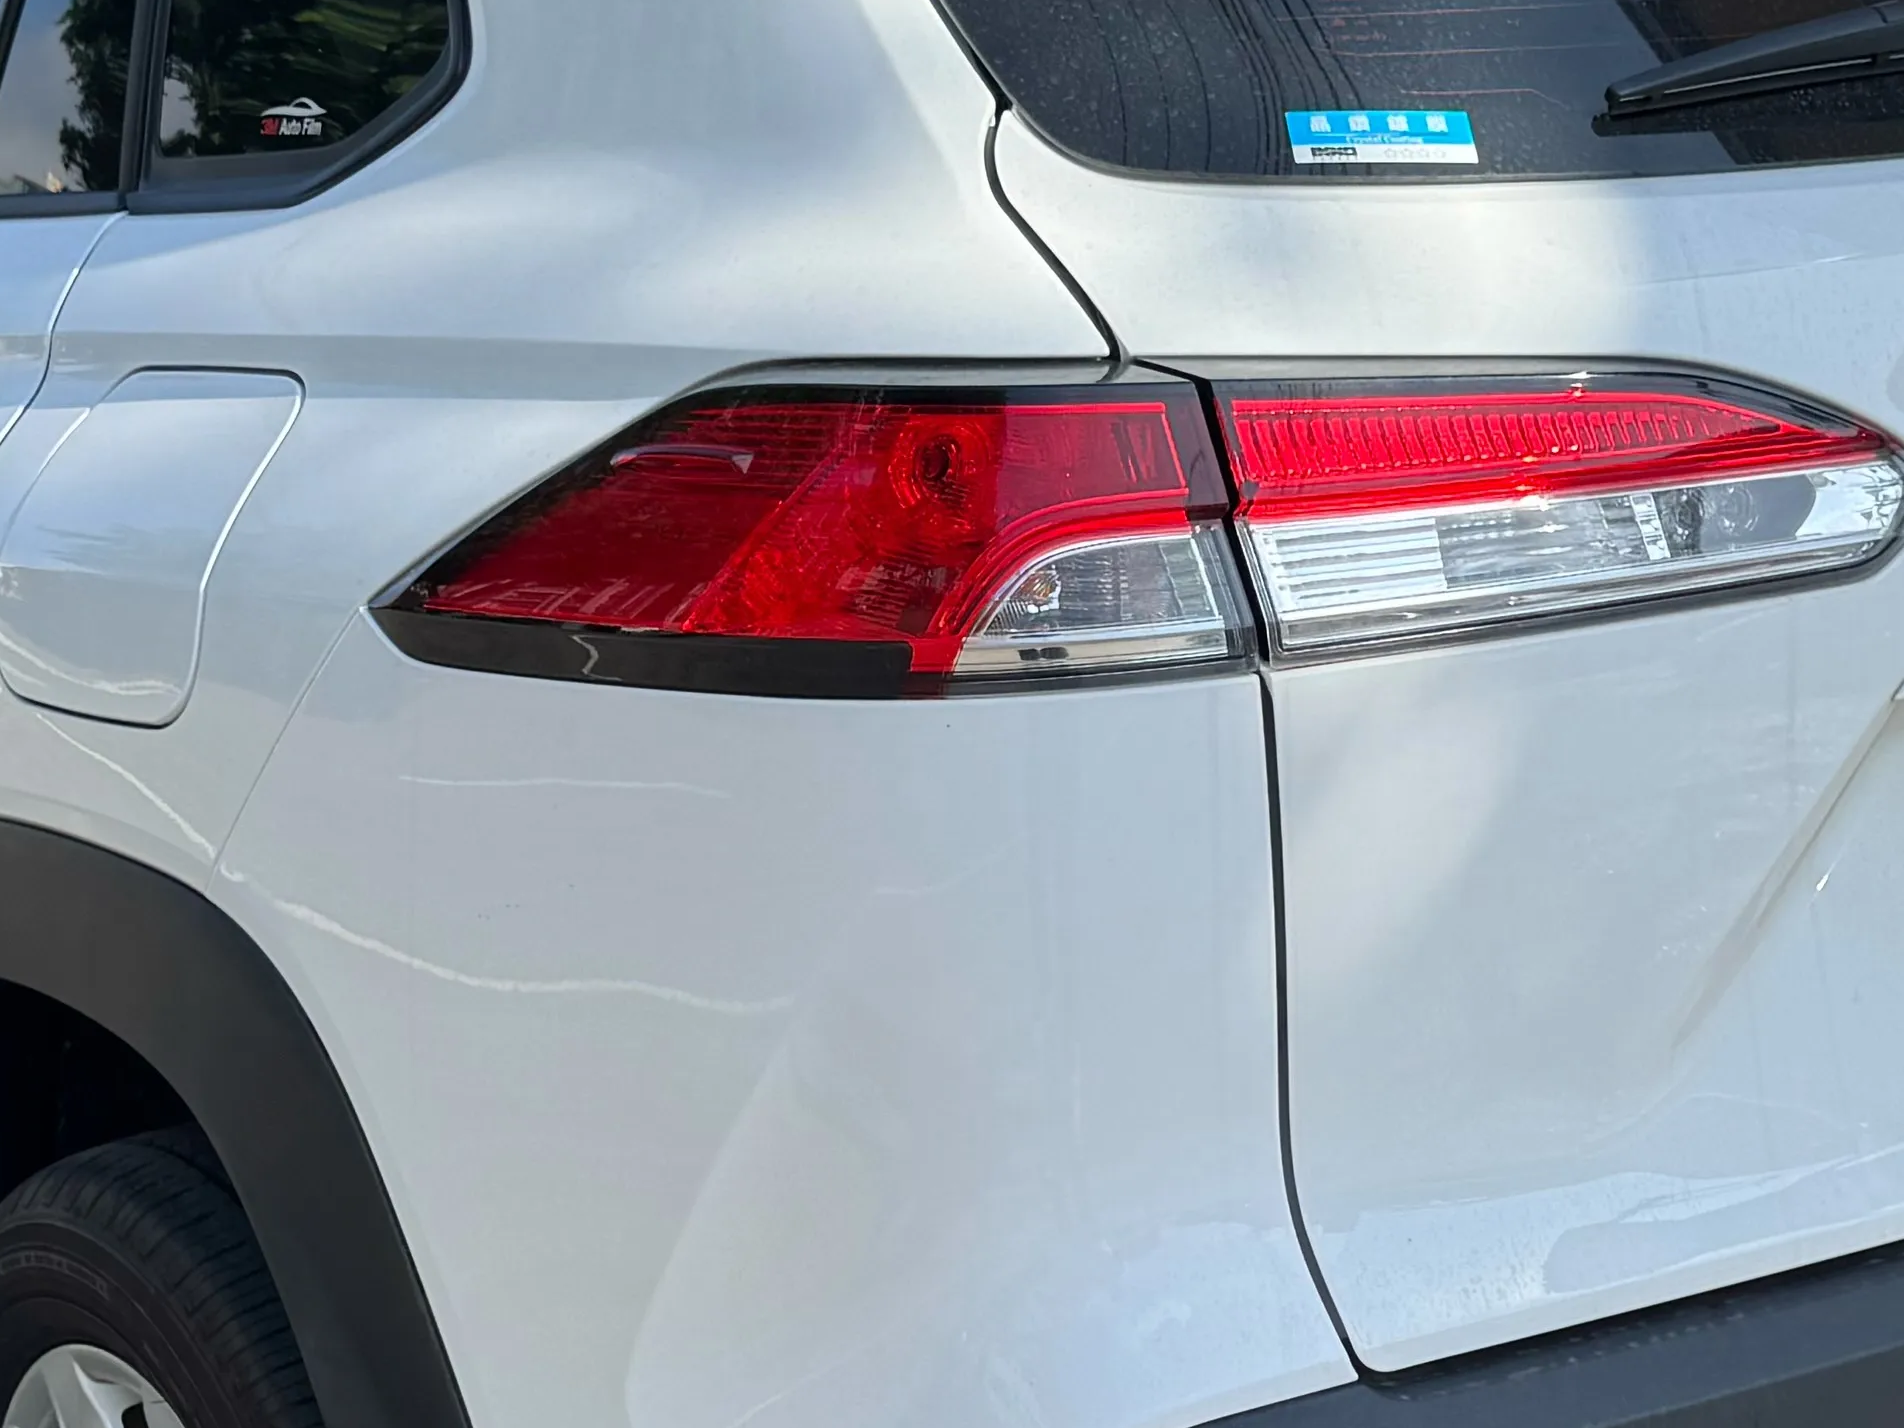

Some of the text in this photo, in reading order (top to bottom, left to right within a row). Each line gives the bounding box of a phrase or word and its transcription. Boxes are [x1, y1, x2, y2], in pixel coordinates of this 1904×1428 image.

[260, 117, 322, 136] 3M Auto Film
